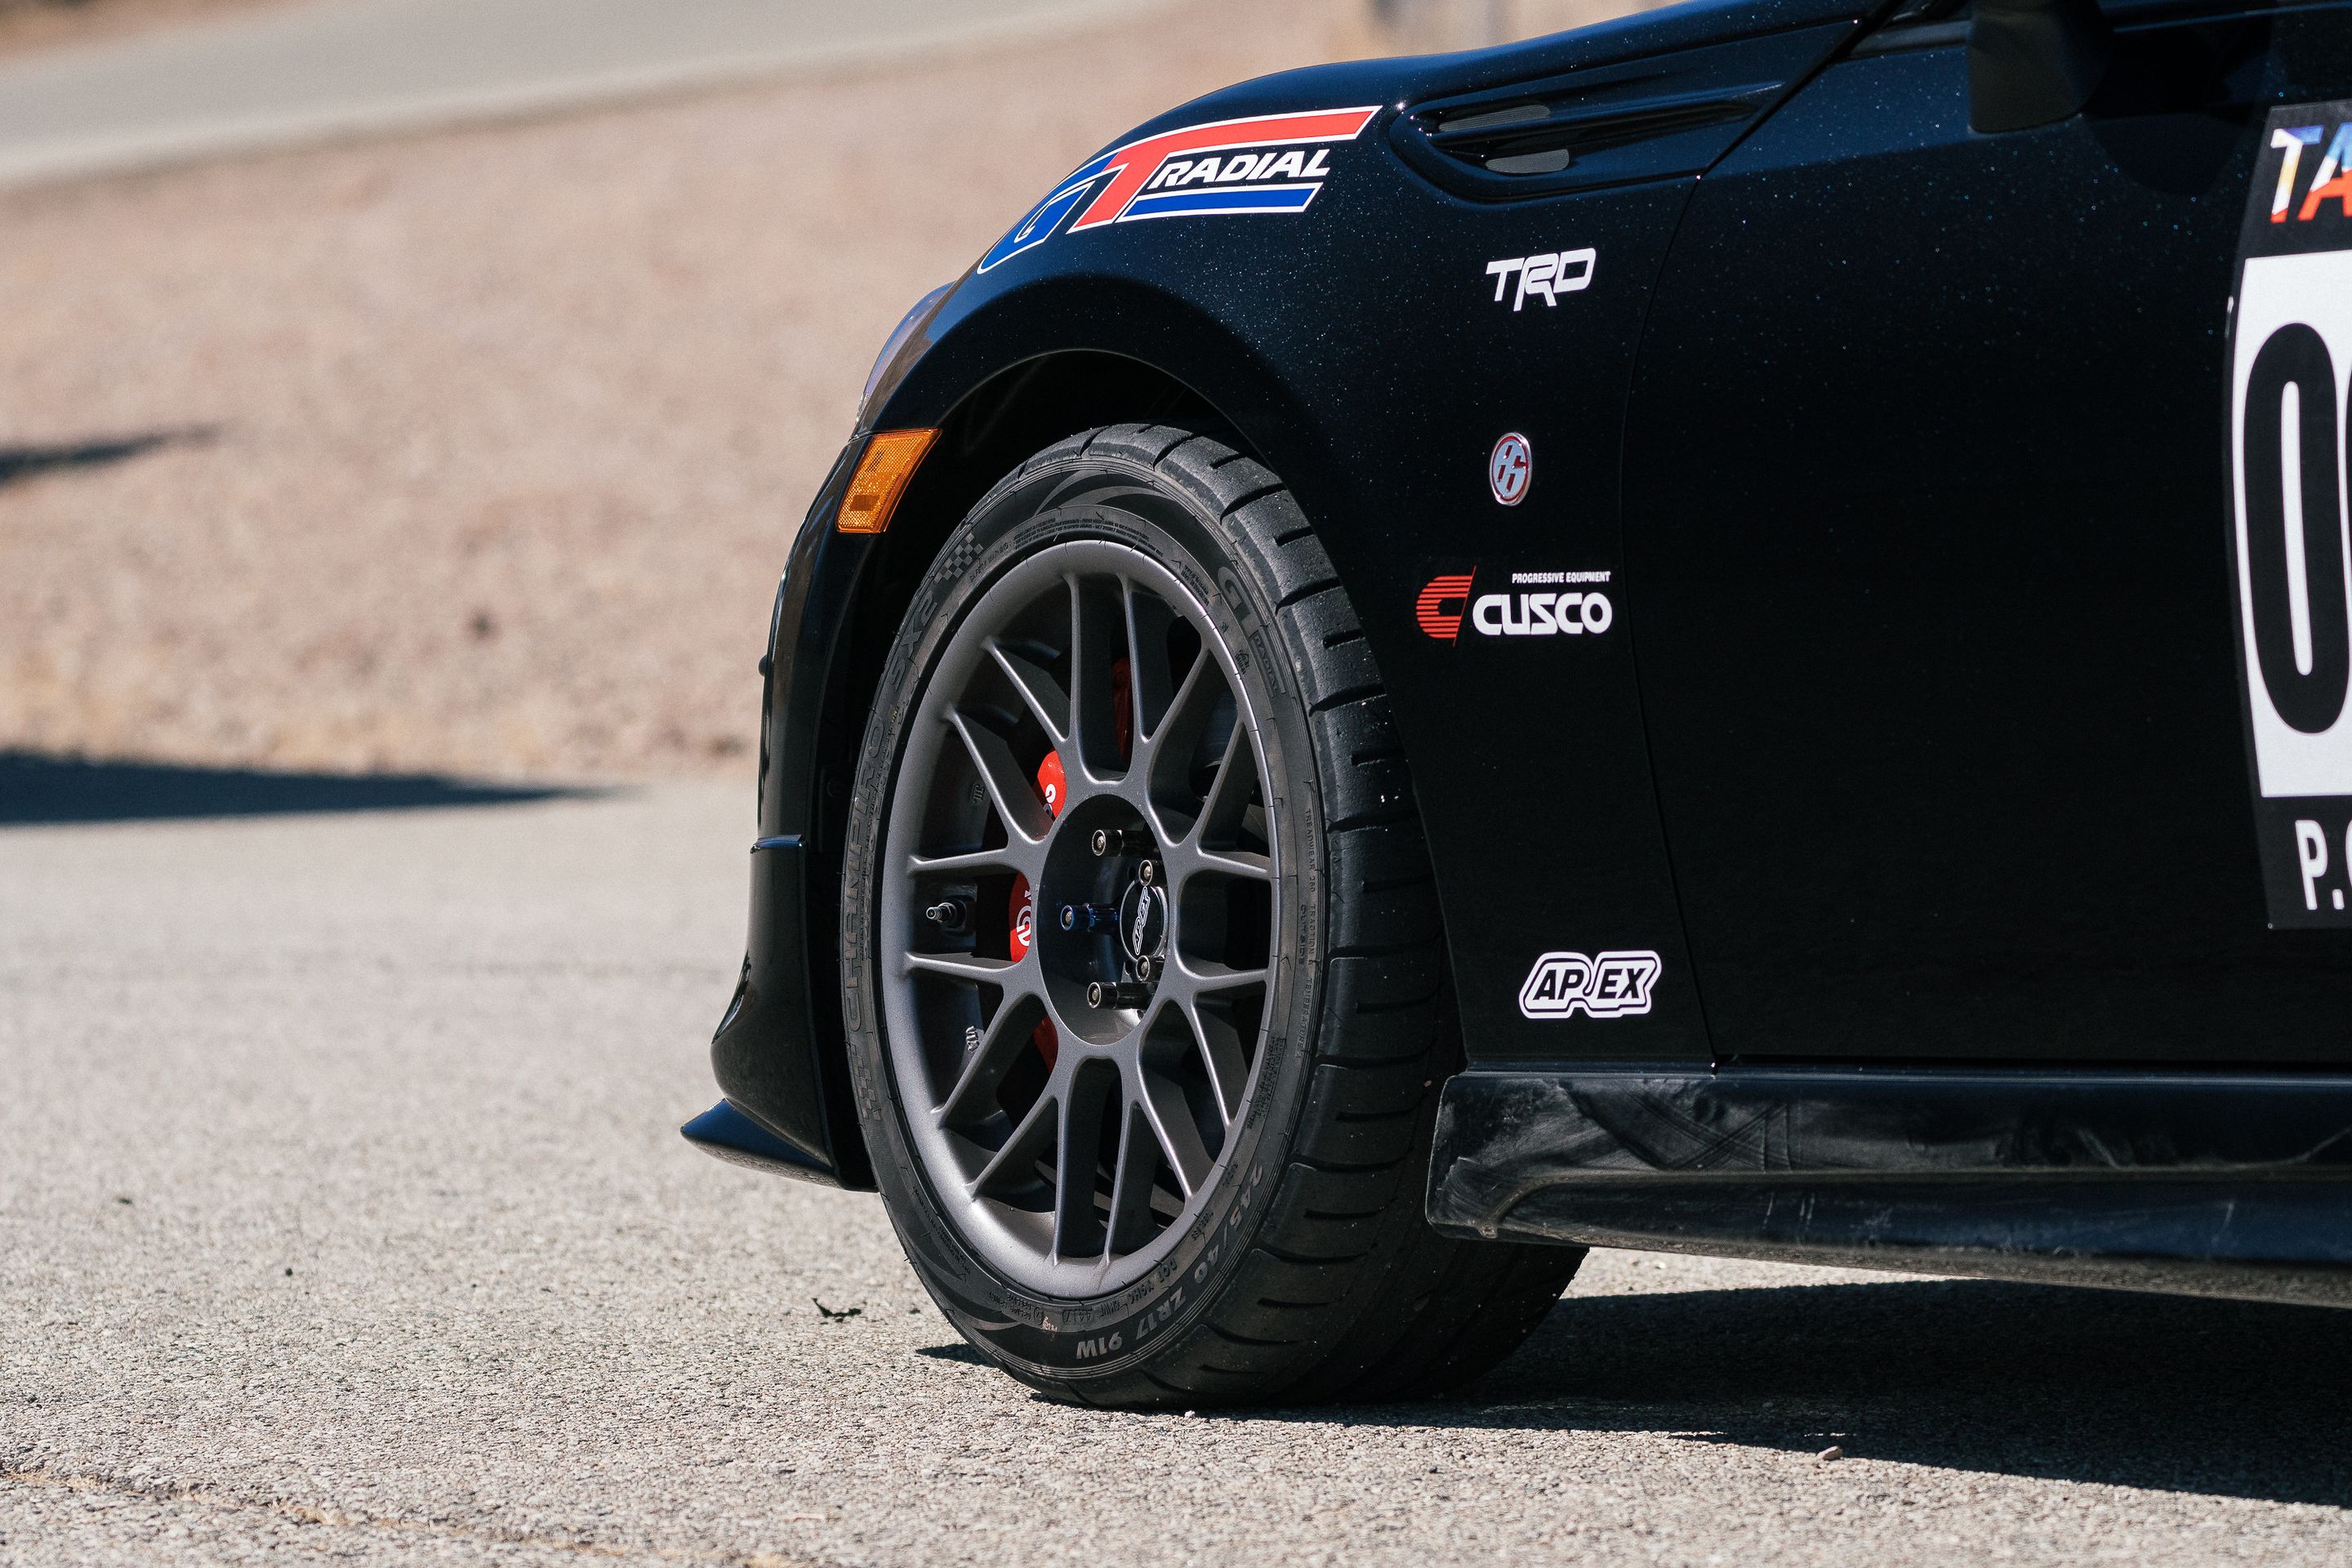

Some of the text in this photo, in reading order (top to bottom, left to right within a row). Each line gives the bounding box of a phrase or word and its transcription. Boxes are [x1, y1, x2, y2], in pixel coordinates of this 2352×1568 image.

[1148, 149, 1331, 189] RADIAL
[1486, 247, 1596, 311] TRD
[2244, 322, 2352, 736] 0
[1512, 571, 1611, 584] PROGRESSIVE EQUIPMENT
[1472, 592, 1613, 636] CUSCO
[1305, 808, 1316, 871] TREADWEAR
[2296, 819, 2352, 911] P.
[844, 719, 884, 1032] CHAMPIRO
[1299, 904, 1307, 965] OUTSIDE
[1308, 903, 1317, 955] TRACTION
[1530, 965, 1650, 1003] APEX
[1297, 978, 1313, 1049] TEMPERATURE
[1135, 1286, 1187, 1340] ZR17
[1076, 1331, 1124, 1360] 91W
